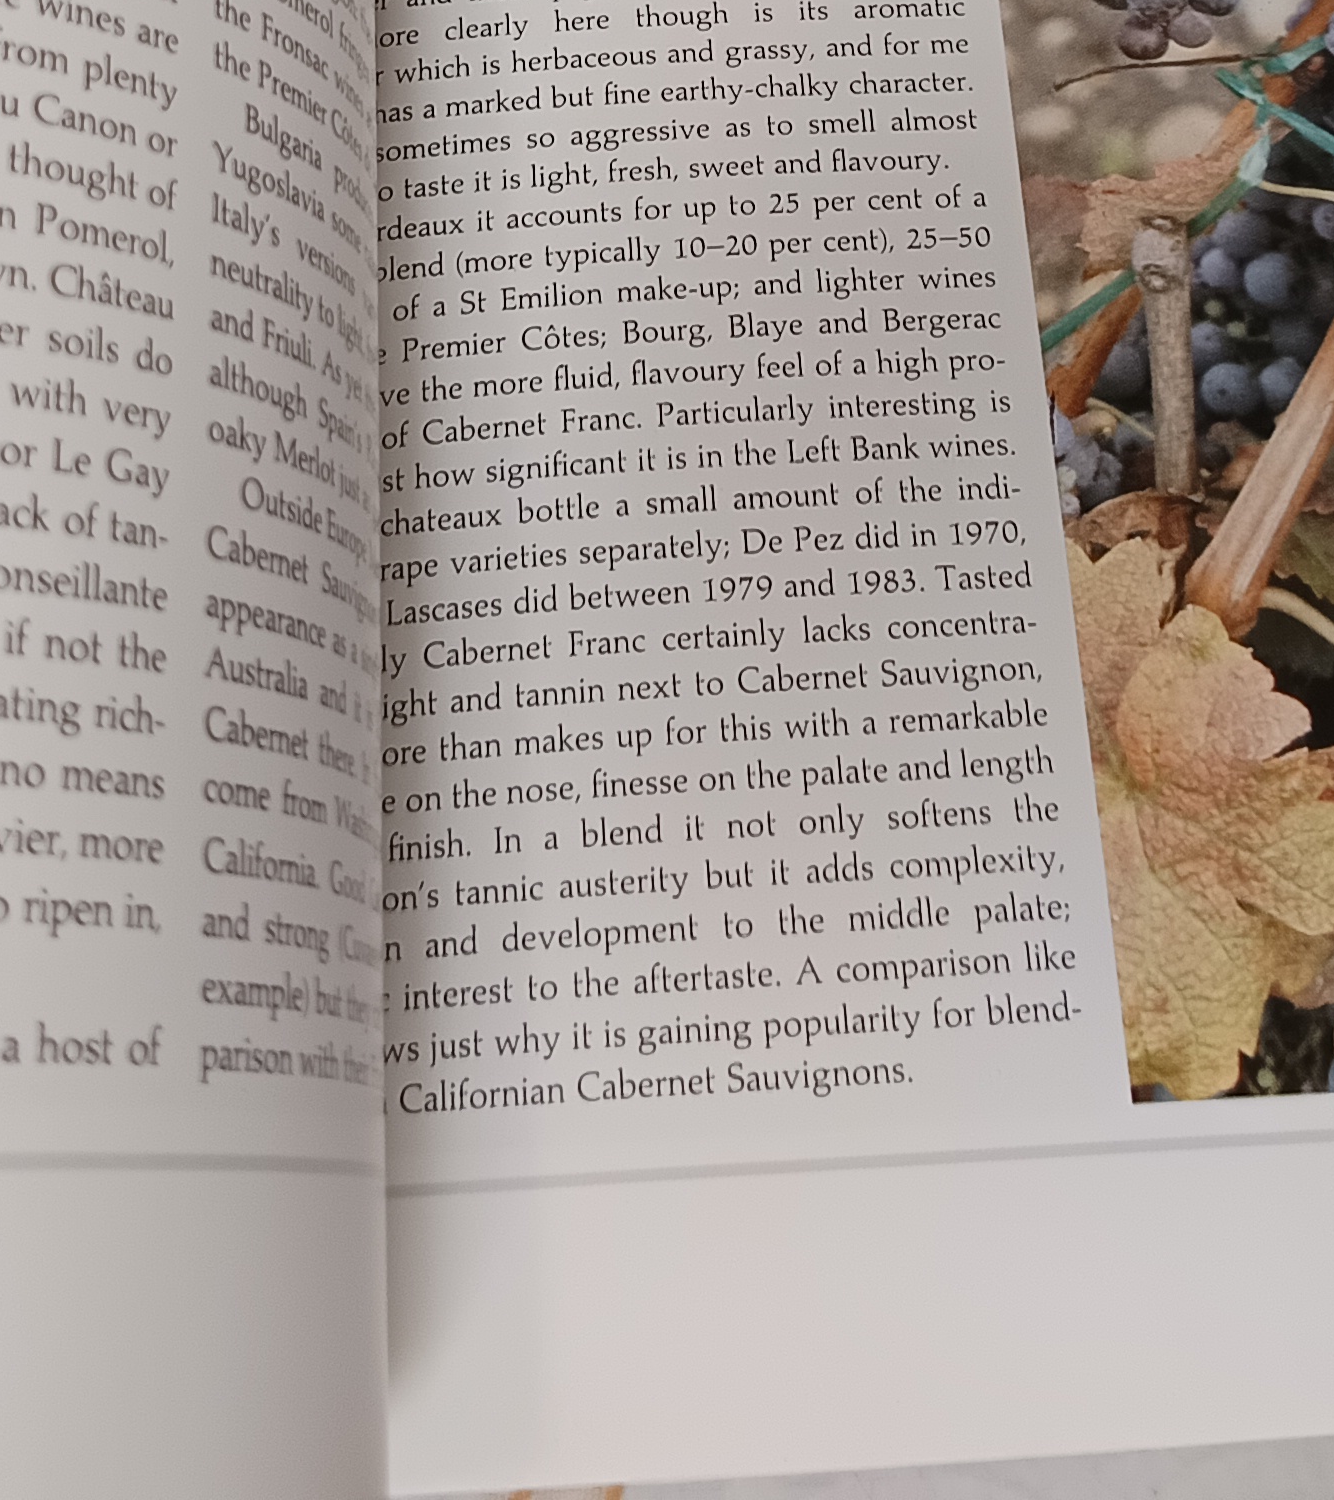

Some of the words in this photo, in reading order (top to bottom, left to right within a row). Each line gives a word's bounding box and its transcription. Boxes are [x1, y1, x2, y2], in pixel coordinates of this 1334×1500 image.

[245, 102, 323, 171] Bulgaria
[381, 419, 410, 450] of
[422, 411, 547, 446] Cabernet
[560, 407, 642, 434] Franc.
[656, 393, 814, 428] Particularly
[828, 391, 977, 422] interesting
[990, 389, 1011, 414] is
[52, 437, 92, 477] Le
[104, 447, 170, 500] Gay
[208, 416, 266, 465] oaky
[272, 430, 338, 490] Merlot
[207, 524, 309, 587] Cabernet
[386, 598, 503, 627] Lascases
[513, 582, 558, 615] did
[568, 581, 691, 611] between
[702, 574, 773, 603] 1979
[784, 567, 836, 599] and
[847, 568, 925, 596] 1983.
[934, 559, 1033, 592] Tasted
[61, 765, 166, 801] means
[399, 1076, 565, 1114] Californian
[576, 1066, 716, 1102] Cabernet
[727, 1059, 914, 1098] Sauvignons.
